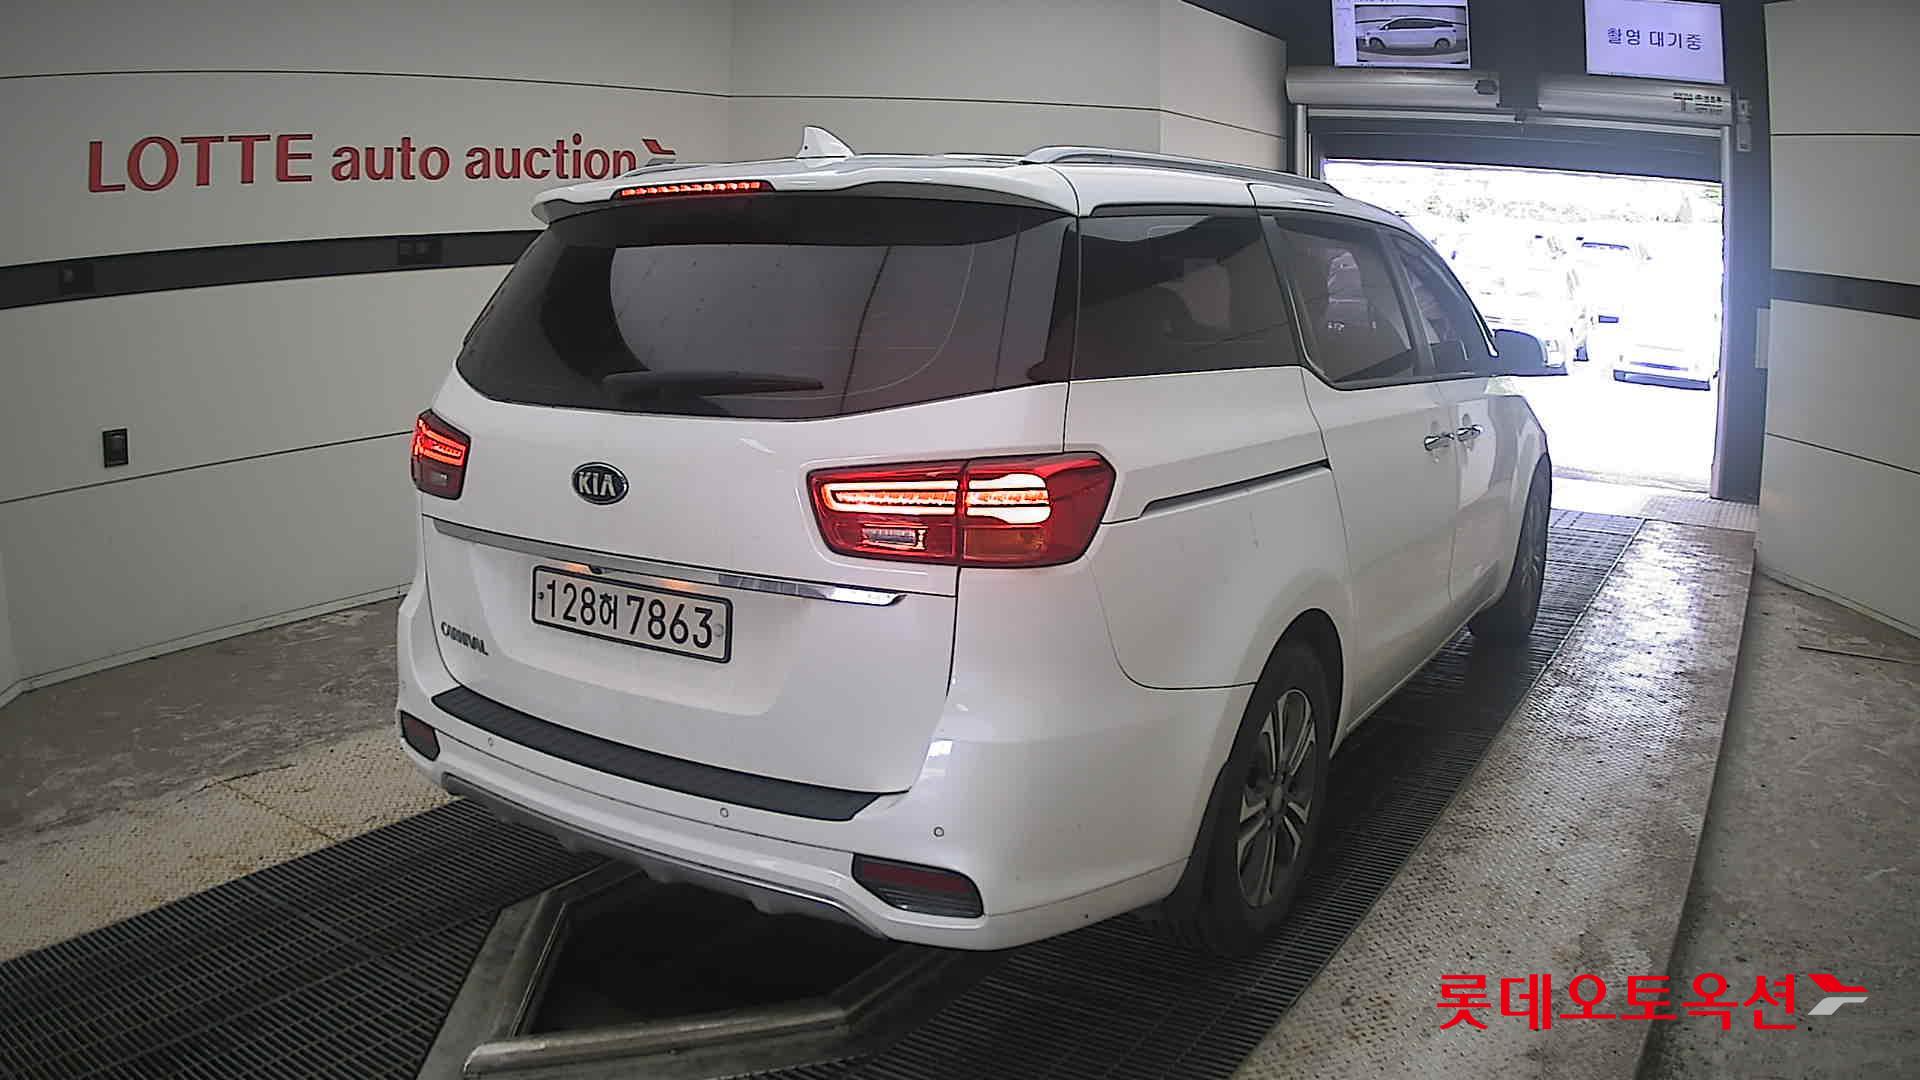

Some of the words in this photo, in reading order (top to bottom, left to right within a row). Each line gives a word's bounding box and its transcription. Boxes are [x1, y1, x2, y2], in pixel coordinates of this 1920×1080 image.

[1649, 31, 1701, 50] 대기중
[88, 134, 312, 193] LOTTE
[331, 136, 450, 181] auto
[465, 132, 637, 180] auction
[578, 471, 616, 497] KIA
